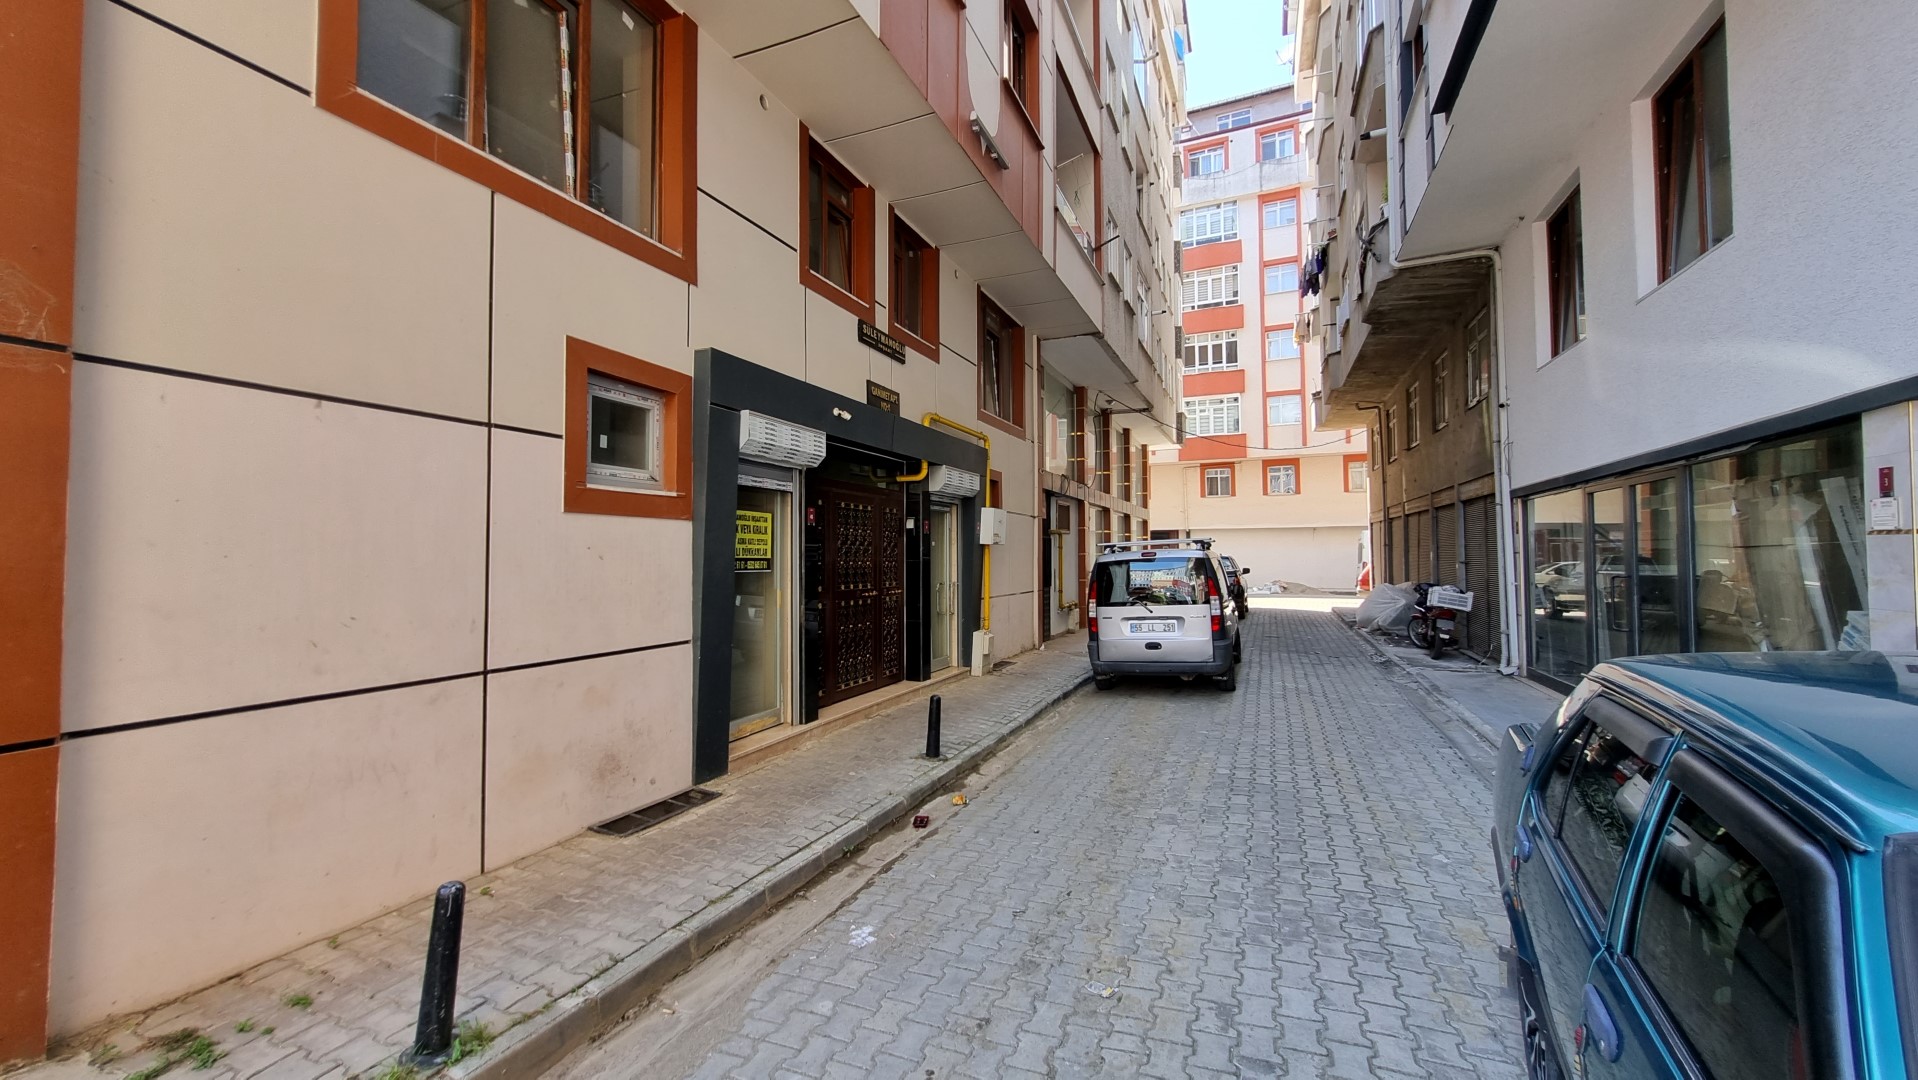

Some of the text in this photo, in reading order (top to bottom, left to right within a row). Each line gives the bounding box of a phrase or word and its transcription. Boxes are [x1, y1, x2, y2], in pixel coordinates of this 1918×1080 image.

[1883, 477, 1889, 487] 3
[740, 524, 751, 534] VEYA
[1135, 623, 1174, 632] 55 LL 251
